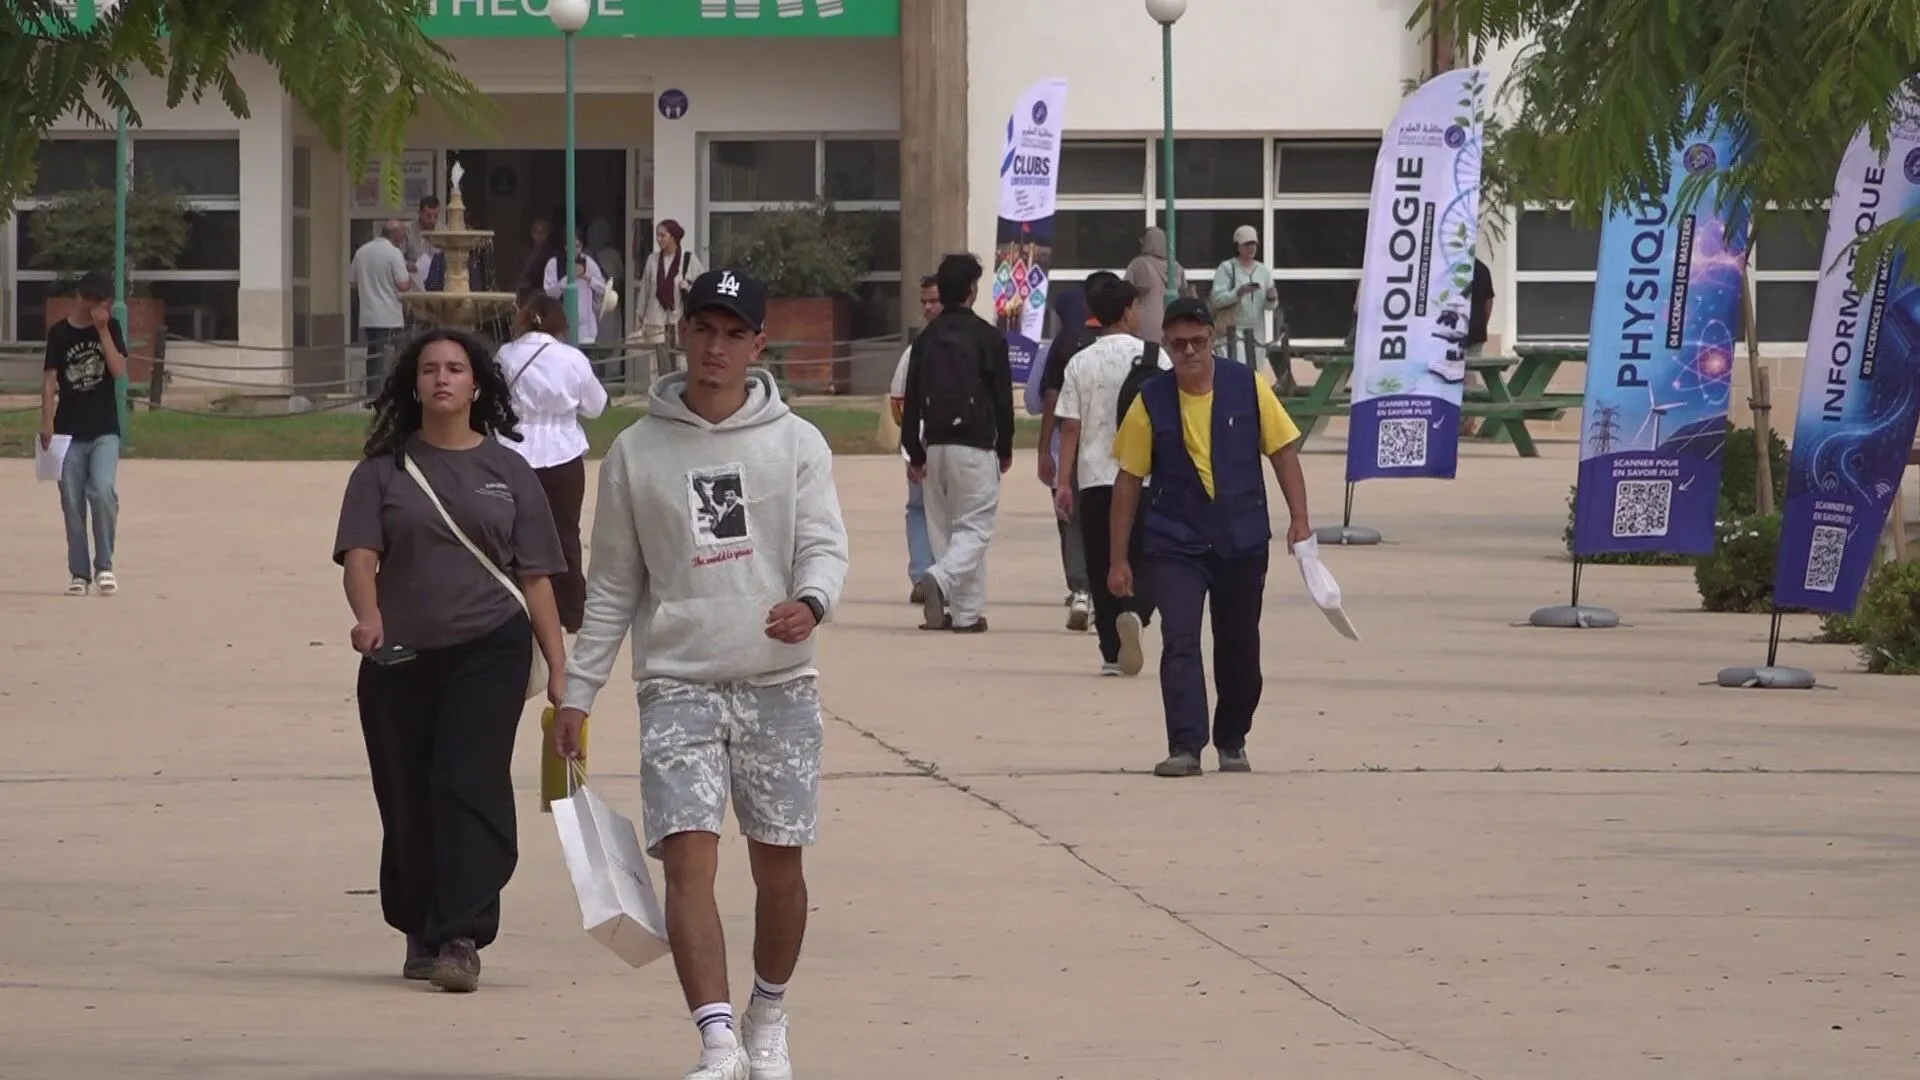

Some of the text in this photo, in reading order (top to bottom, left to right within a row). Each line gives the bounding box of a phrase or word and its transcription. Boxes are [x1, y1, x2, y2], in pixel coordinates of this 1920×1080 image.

[1013, 155, 1051, 176] CLUBS
[1678, 216, 1692, 263] MASTERS
[1379, 157, 1423, 360] BIOLOGIE
[717, 270, 740, 297] LA
[1676, 265, 1687, 278] 02
[1823, 166, 1885, 422] INFORMQUE
[1671, 284, 1685, 331] LICENCES
[1670, 334, 1679, 346] 04
[1865, 304, 1883, 358] LICENCES
[1863, 361, 1873, 374] 03
[1612, 468, 1679, 477] EN SAVOIR PLUS
[1613, 459, 1679, 467] SCANNER POUR
